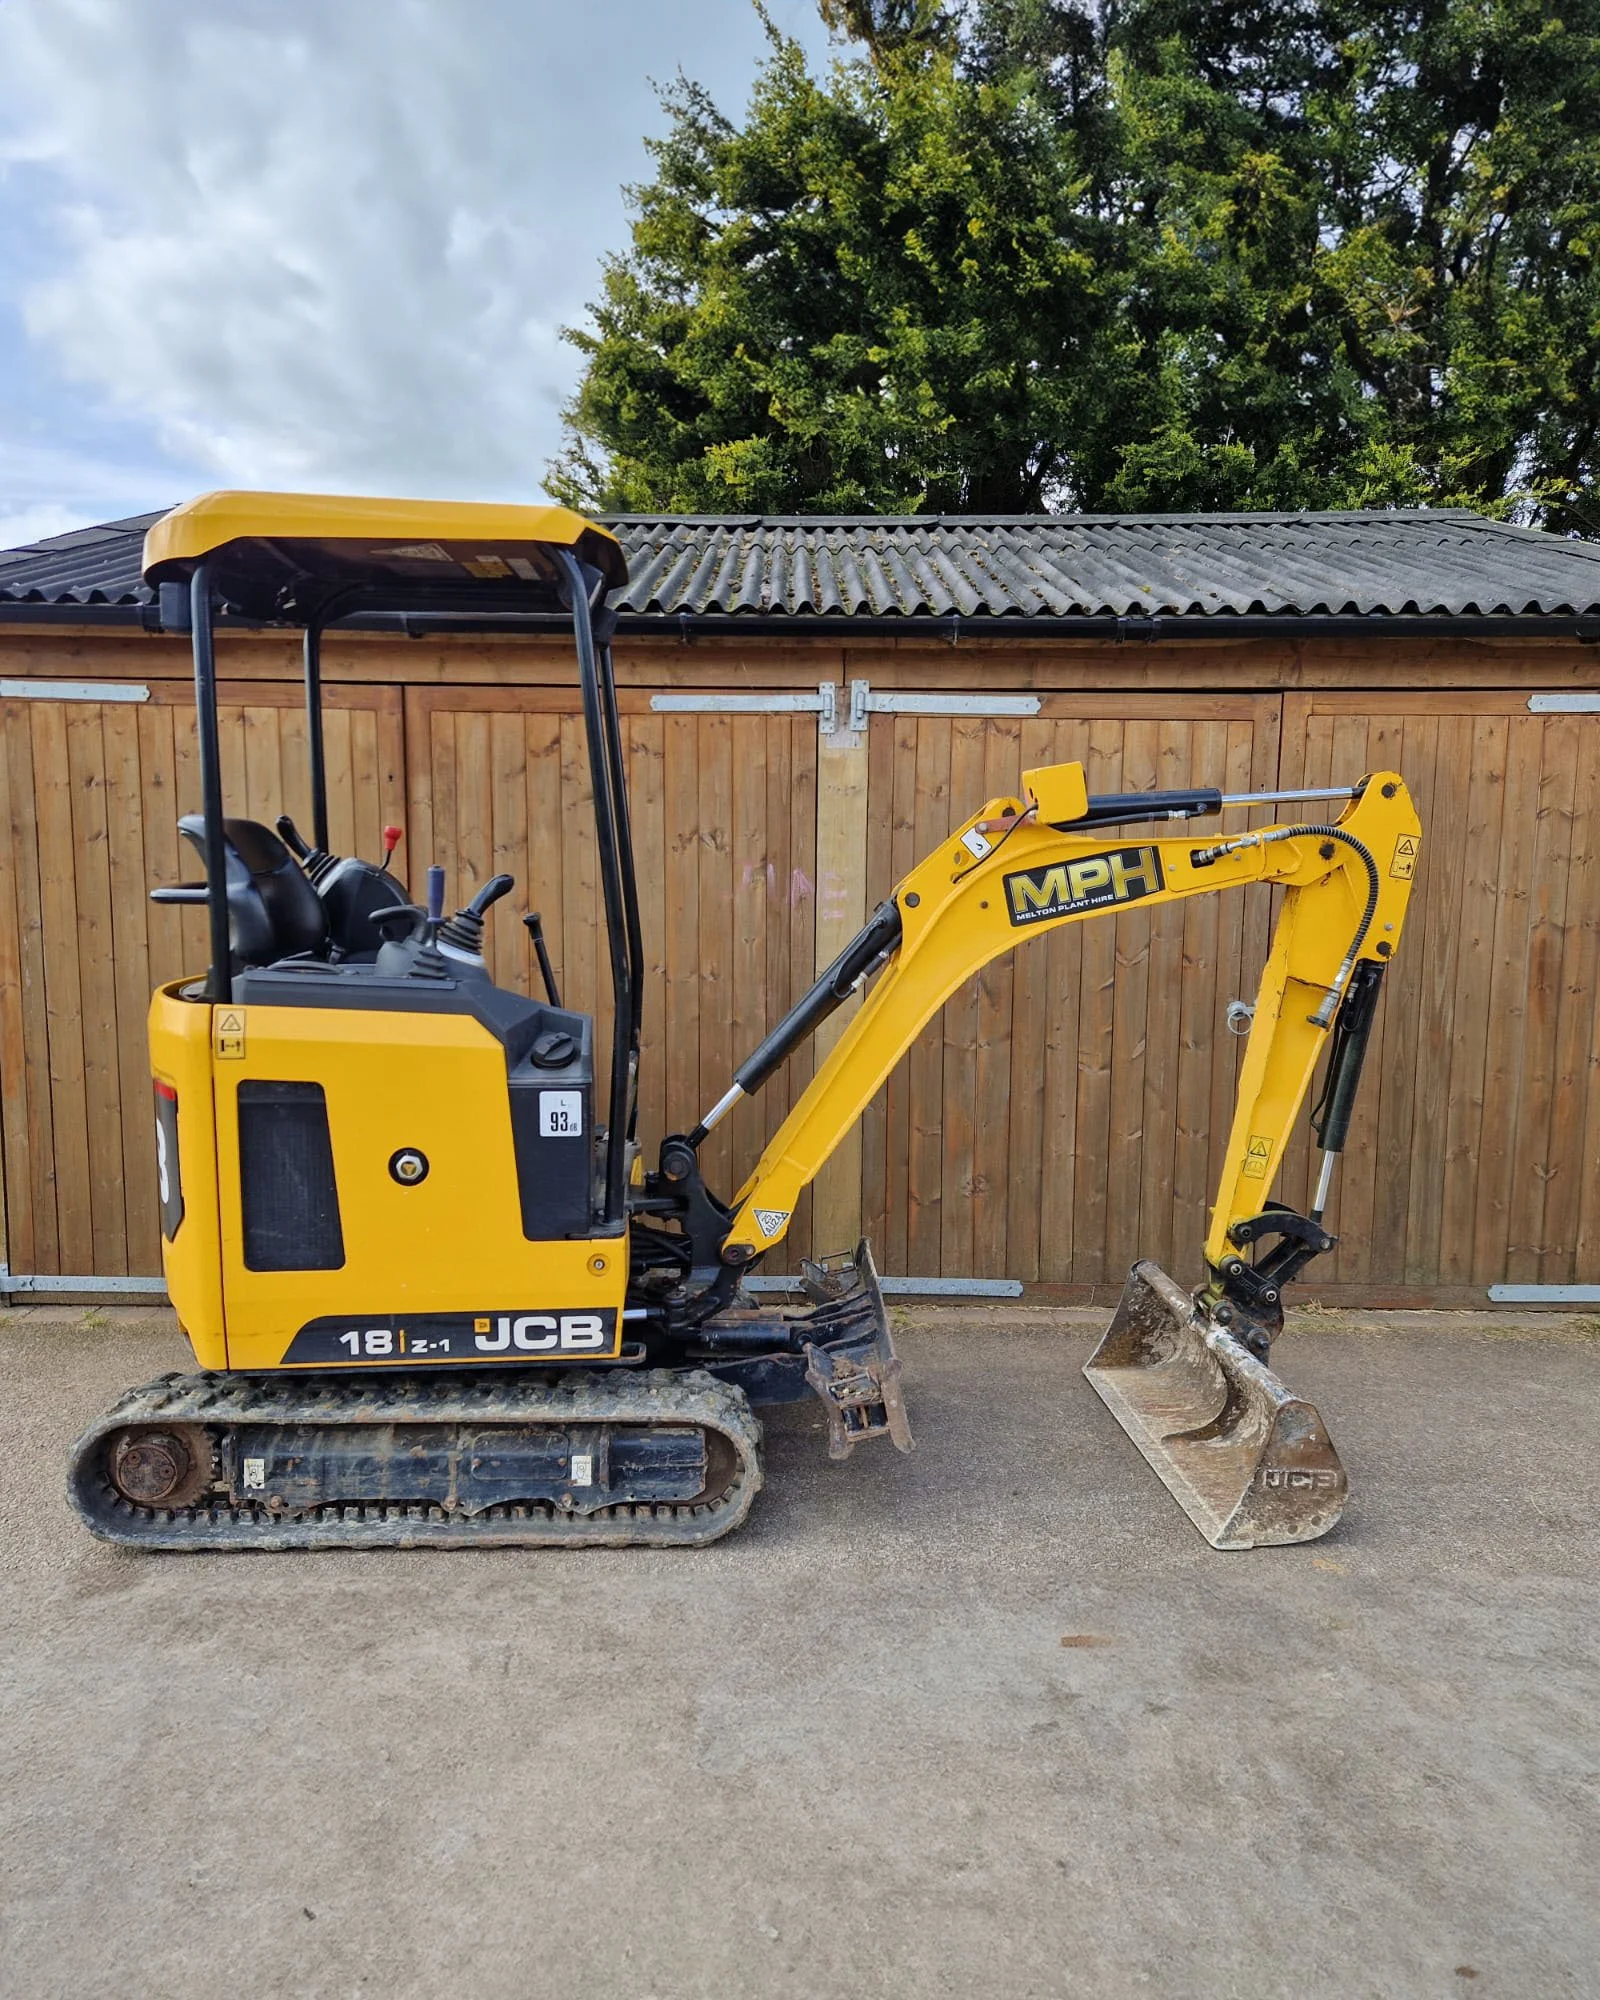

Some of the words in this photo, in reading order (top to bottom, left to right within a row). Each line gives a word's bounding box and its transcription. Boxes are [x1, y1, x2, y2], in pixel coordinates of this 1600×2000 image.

[1009, 847, 1159, 913] MPH
[1016, 906, 1056, 921] MELTON
[1058, 899, 1089, 911] PLANT
[1091, 893, 1114, 904] HIRE
[550, 1111, 568, 1132] 93
[474, 1315, 604, 1351] JCB
[1262, 1468, 1337, 1490] JCB
